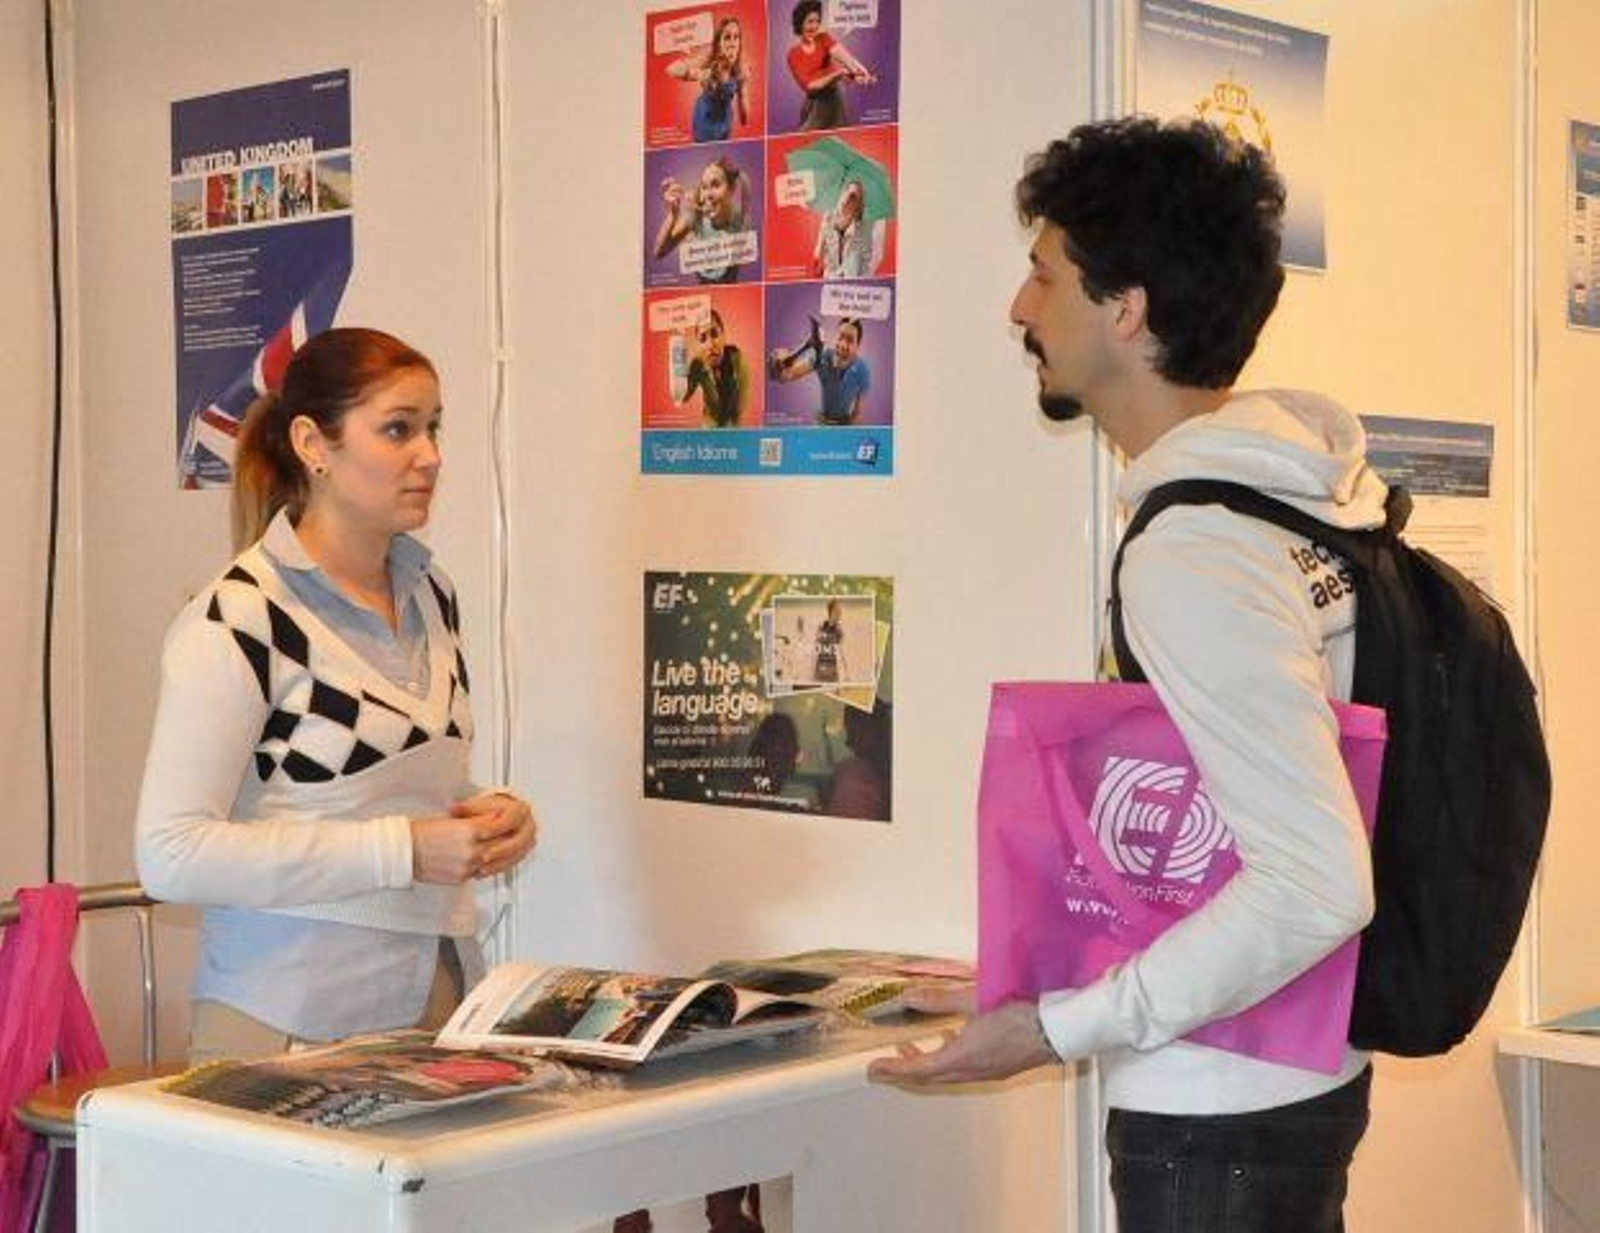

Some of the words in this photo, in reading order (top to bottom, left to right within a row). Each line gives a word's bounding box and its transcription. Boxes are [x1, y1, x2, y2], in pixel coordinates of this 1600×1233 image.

[181, 151, 236, 176] UNITED
[241, 137, 314, 164] KINGDOM
[653, 443, 695, 464] English
[697, 443, 739, 460] Idioms
[857, 445, 876, 460] EF
[1290, 541, 1337, 575] tec
[653, 583, 684, 609] EF
[652, 659, 698, 687] Live
[700, 656, 741, 684] the
